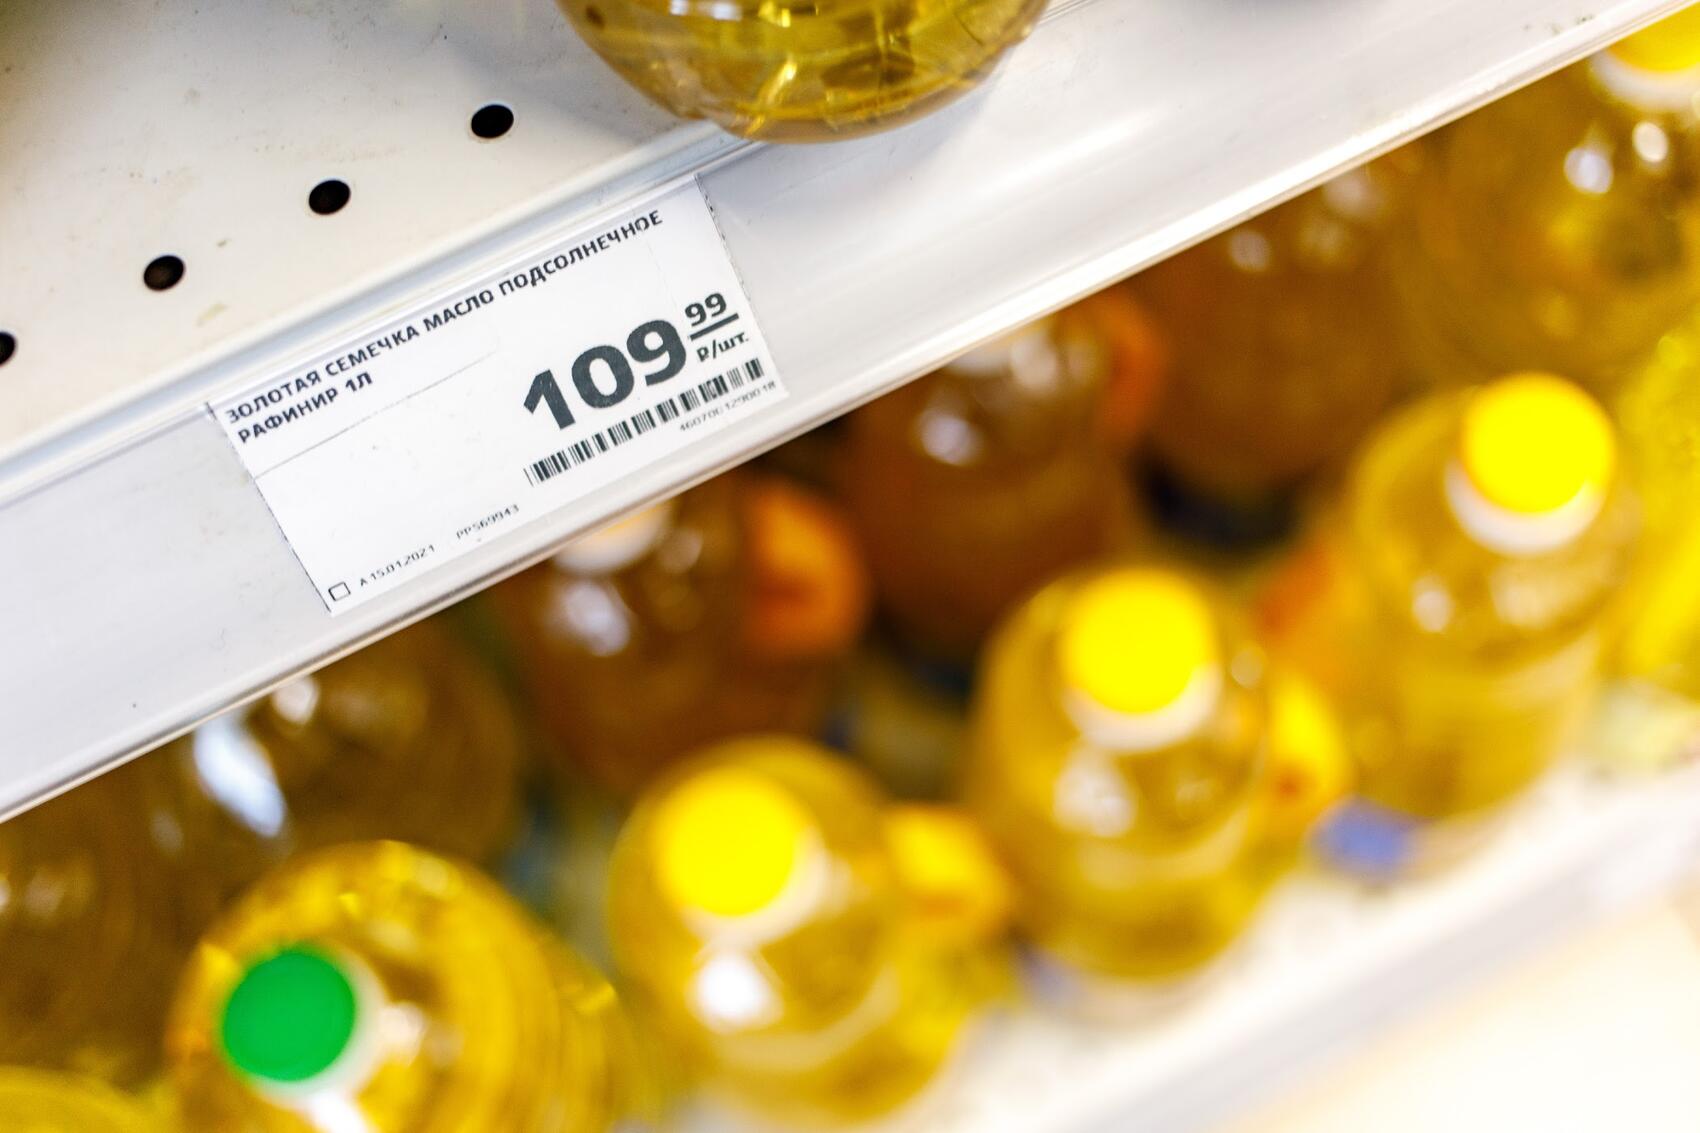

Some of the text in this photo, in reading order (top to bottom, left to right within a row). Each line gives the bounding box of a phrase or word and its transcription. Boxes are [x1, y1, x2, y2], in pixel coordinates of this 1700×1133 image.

[225, 209, 663, 424] ЗОЛОТАЯ СЕМЕЧКА МАСЛО ПОДСОЛНЕЧНОЕ
[523, 292, 727, 430] 109 99
[237, 371, 373, 443] РАФИНИР 1Л
